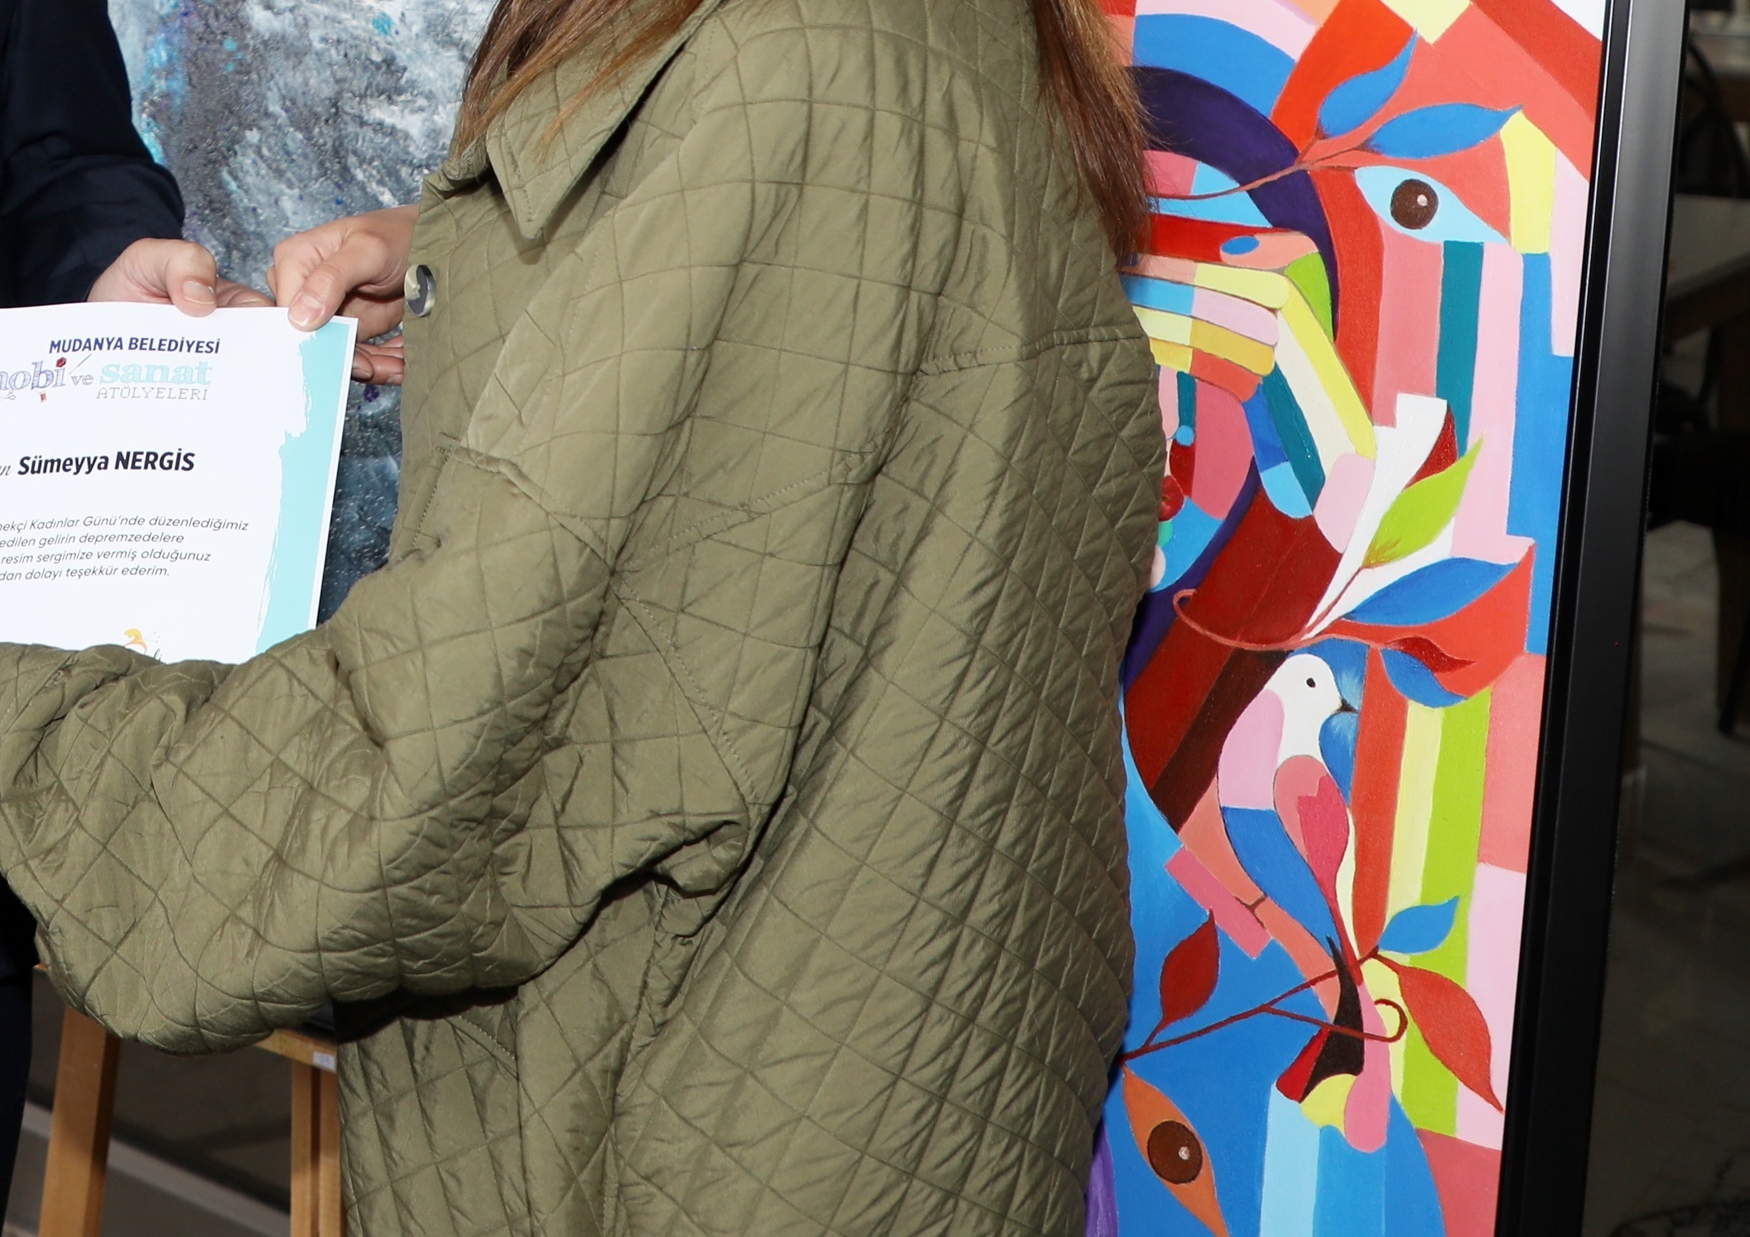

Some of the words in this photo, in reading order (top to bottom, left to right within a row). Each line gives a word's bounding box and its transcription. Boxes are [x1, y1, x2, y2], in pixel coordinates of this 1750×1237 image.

[49, 337, 123, 354] MUDANYA
[128, 336, 220, 354] BELEDİYESİ
[71, 373, 94, 386] ve
[99, 360, 213, 385] sanat
[96, 386, 209, 401] ATÖLYELERİ
[17, 455, 109, 475] Sümeyya
[114, 448, 196, 472] NERGİS
[29, 517, 80, 530] Kadınlar
[149, 515, 249, 532] düzenlediğimiz
[0, 536, 36, 548] edilen
[38, 534, 76, 548] gelirin
[79, 532, 185, 545] depremzedelere
[1, 553, 34, 565] resim
[36, 550, 93, 565] sergimize
[97, 548, 137, 562] vermiş
[140, 548, 211, 563] olduğunuz
[25, 568, 63, 581] dolayı
[66, 565, 118, 580] teşekkür
[121, 565, 170, 577] ederim.
